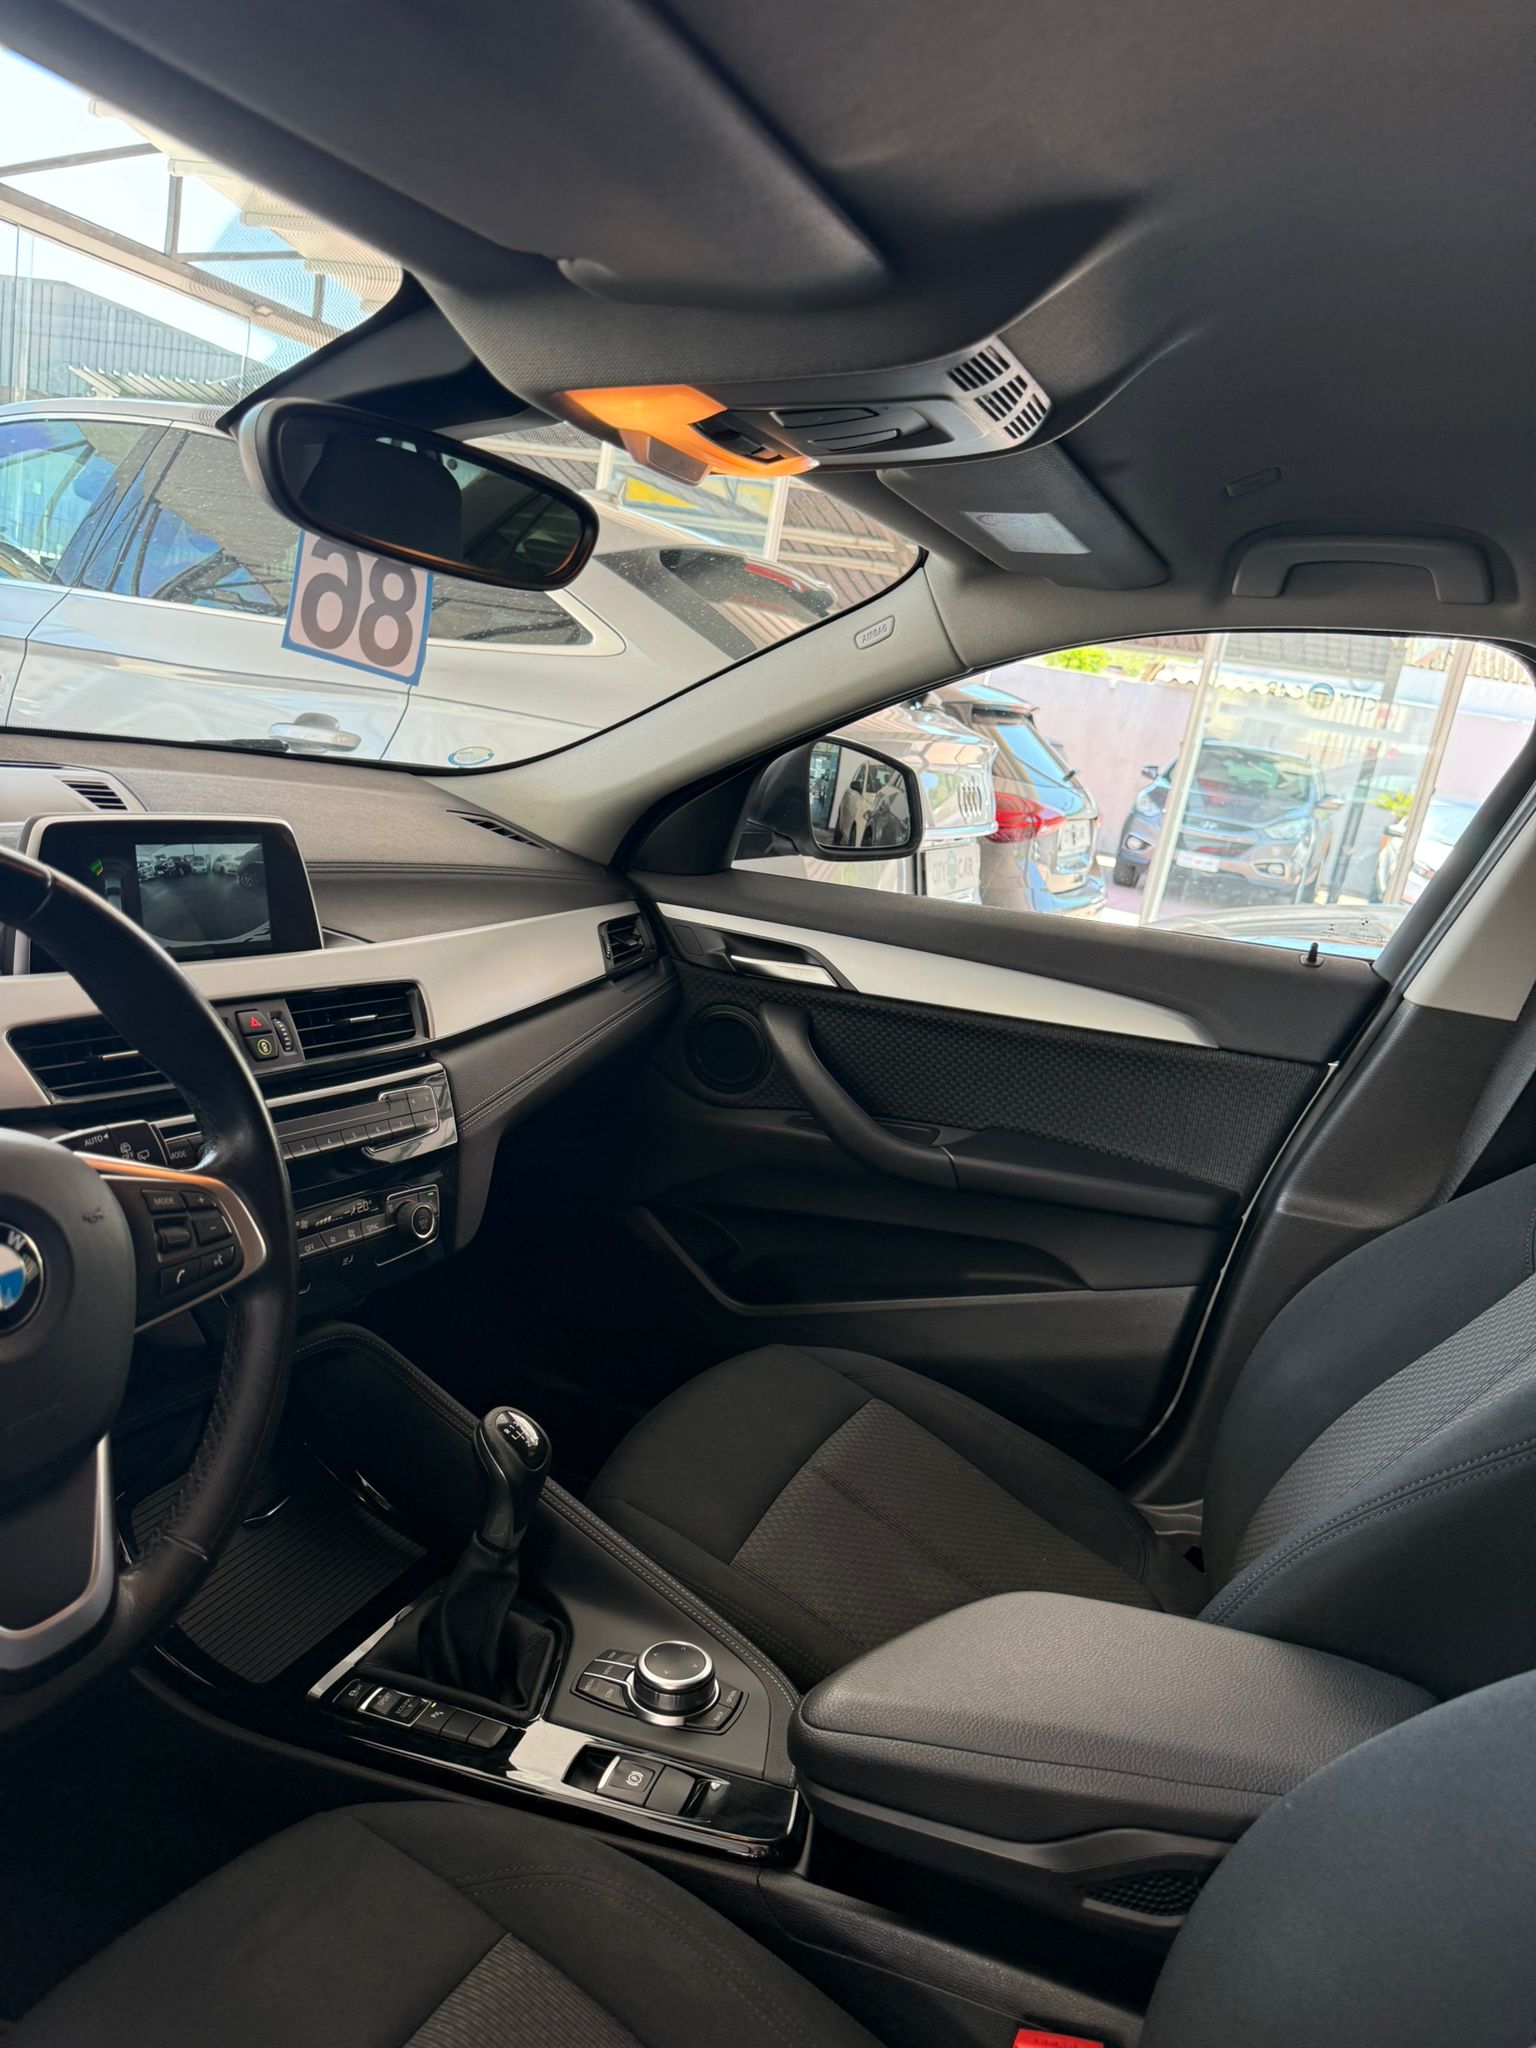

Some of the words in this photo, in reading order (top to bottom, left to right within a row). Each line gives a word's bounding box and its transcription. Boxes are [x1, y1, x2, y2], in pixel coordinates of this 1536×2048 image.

[862, 624, 887, 643] AIRBAG
[958, 857, 974, 878] CAR
[84, 1136, 104, 1147] AUTO
[153, 1197, 175, 1205] MODE
[304, 1243, 315, 1251] OFF
